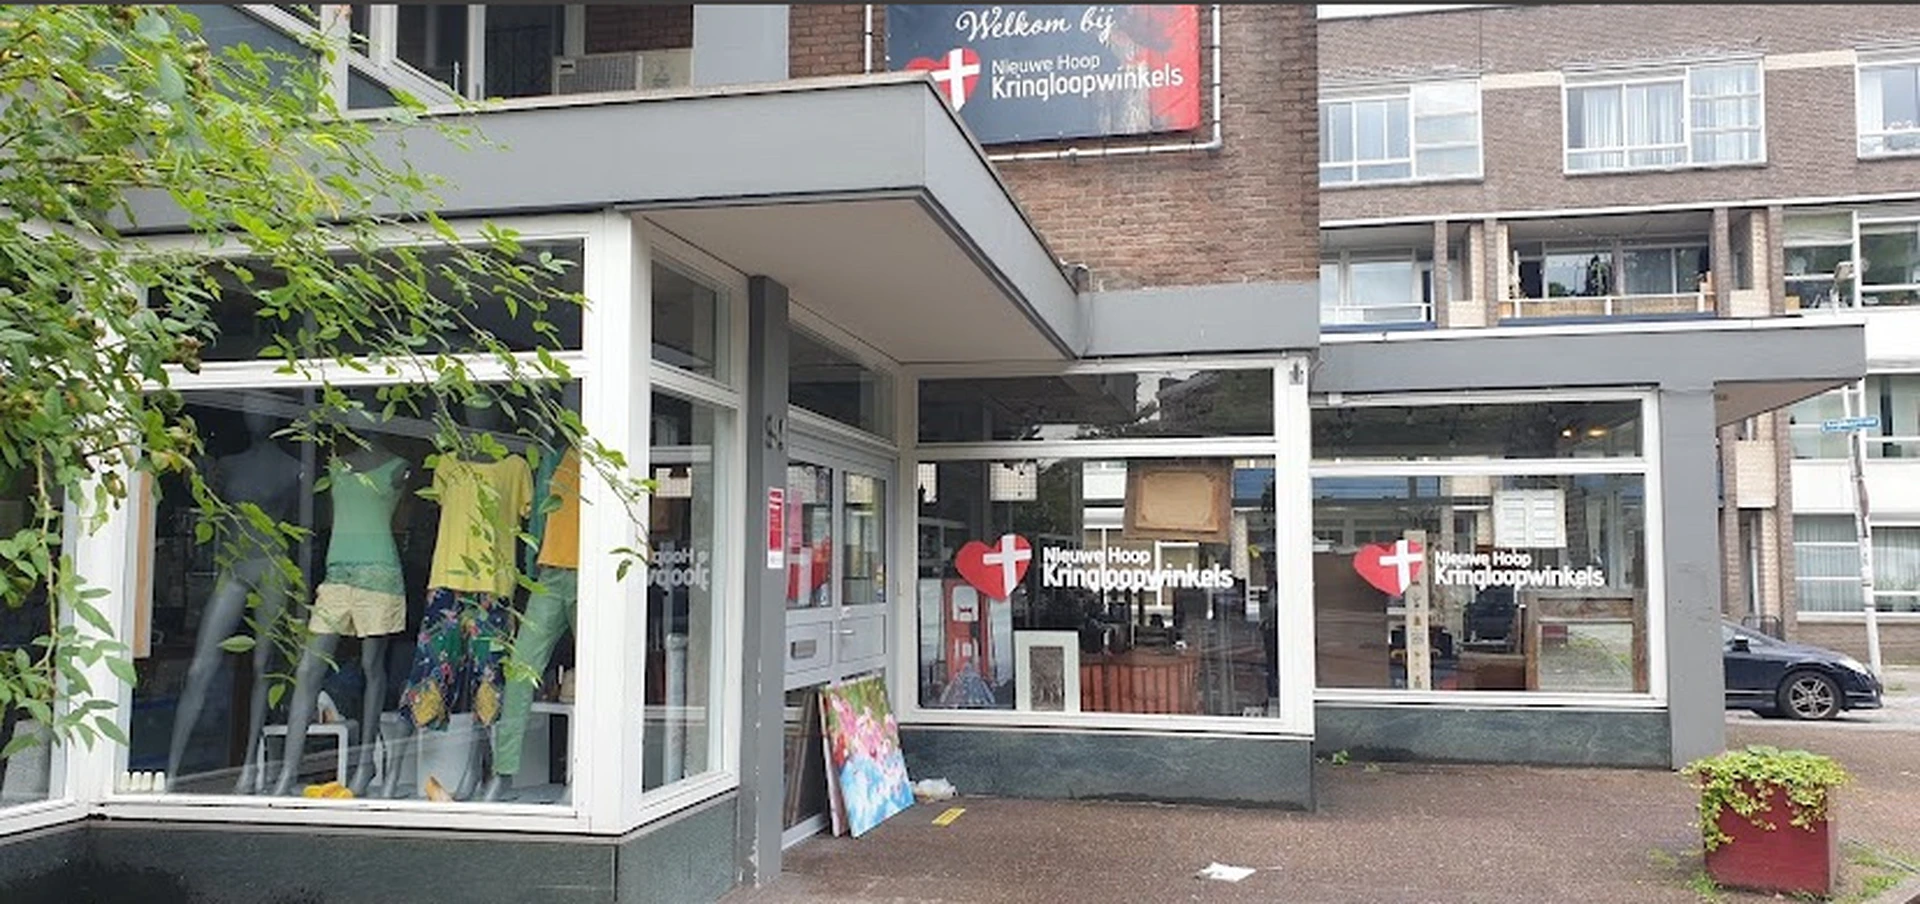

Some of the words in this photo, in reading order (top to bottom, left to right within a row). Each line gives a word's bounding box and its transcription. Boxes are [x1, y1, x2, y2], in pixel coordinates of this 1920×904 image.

[956, 6, 1071, 41] Welkom
[1080, 6, 1115, 42] bij
[992, 59, 1052, 75] Nieuwe
[1058, 55, 1100, 71] Hoop
[991, 65, 1184, 102] Kringloopwinkels
[1043, 547, 1103, 563] Nieuwe
[1108, 547, 1150, 566] Hoop
[1434, 551, 1489, 566] Nieuwe
[1493, 551, 1532, 568] Hoop
[1043, 563, 1234, 593] Kringloopwinkels
[1434, 565, 1605, 591] Kringloopwinkels
